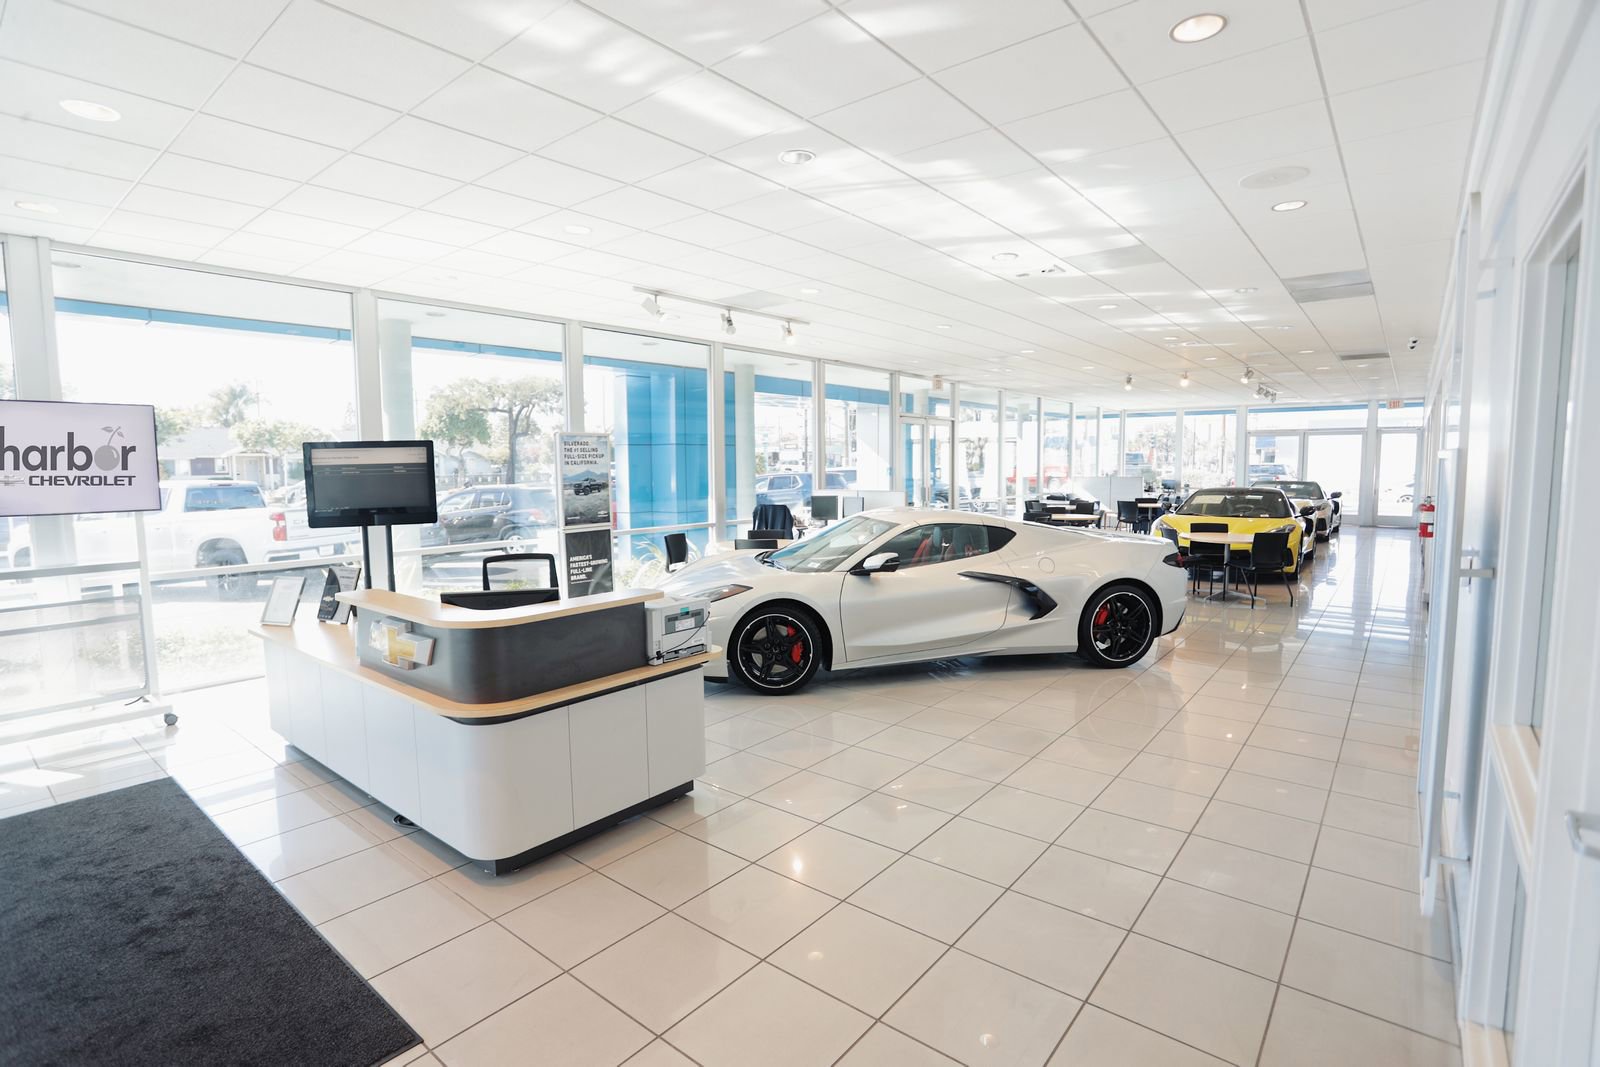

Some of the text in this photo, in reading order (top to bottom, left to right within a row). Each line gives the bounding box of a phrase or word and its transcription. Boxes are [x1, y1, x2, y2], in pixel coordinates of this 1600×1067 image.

[0, 426, 136, 471] harbor
[28, 475, 137, 487] CHEVROLET
[570, 554, 593, 562] AMERICA'S
[570, 559, 608, 568] FASTEST-GROWING
